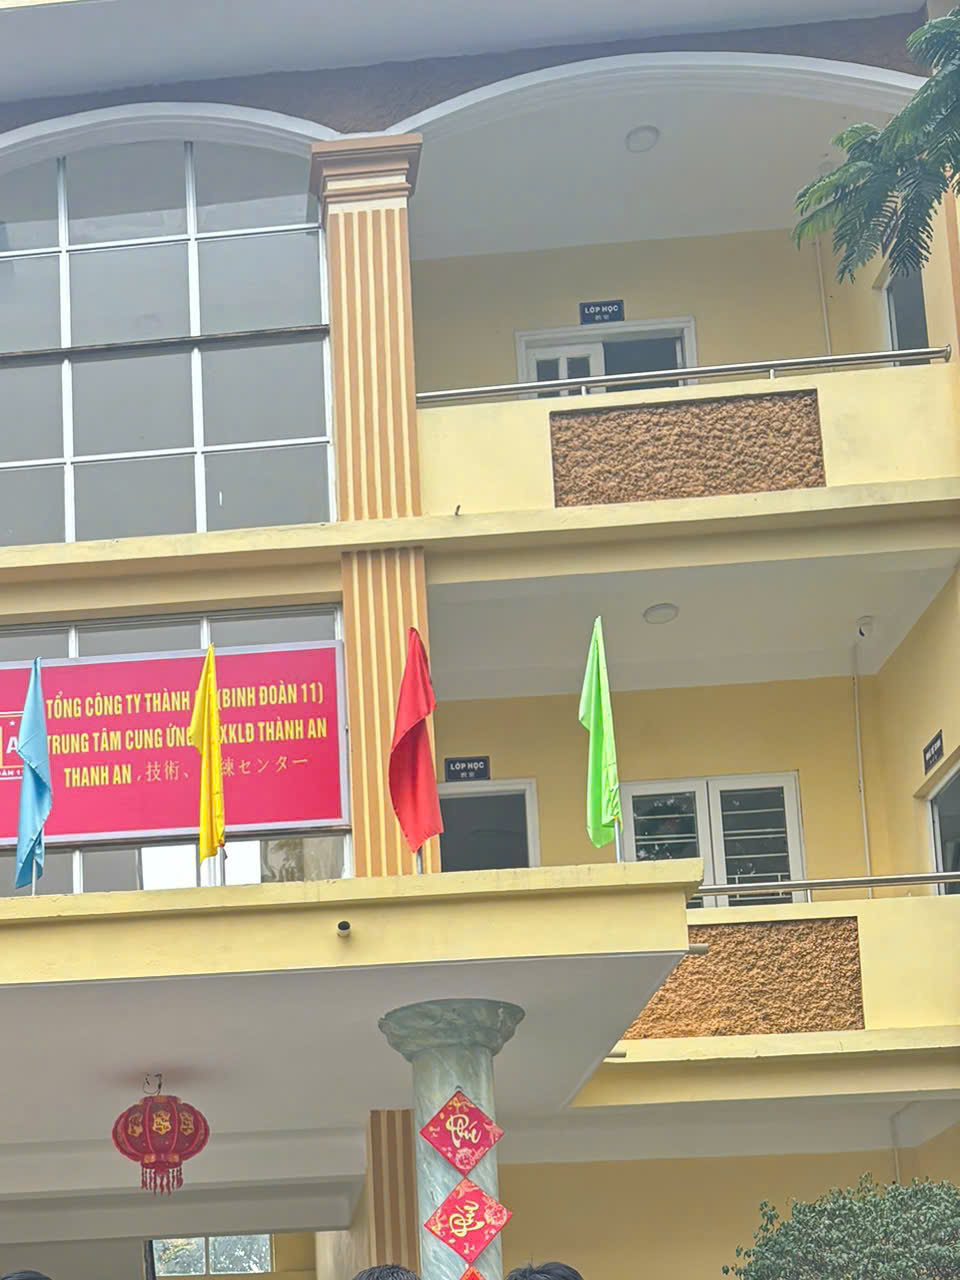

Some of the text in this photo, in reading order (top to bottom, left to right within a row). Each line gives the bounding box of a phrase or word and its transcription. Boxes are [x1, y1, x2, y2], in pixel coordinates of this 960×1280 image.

[46, 690, 82, 719] TỔNG
[85, 692, 123, 717] CÔNG
[126, 693, 141, 714] TY
[144, 688, 190, 712] THÀNH
[259, 680, 298, 706] ĐOÀN
[301, 682, 324, 704] 11)
[92, 728, 121, 752] TÂM
[125, 728, 163, 750] CUNG
[257, 716, 303, 742] THÀNH
[308, 718, 327, 738] AN
[64, 766, 109, 788] THANH
[112, 764, 132, 784] AN
